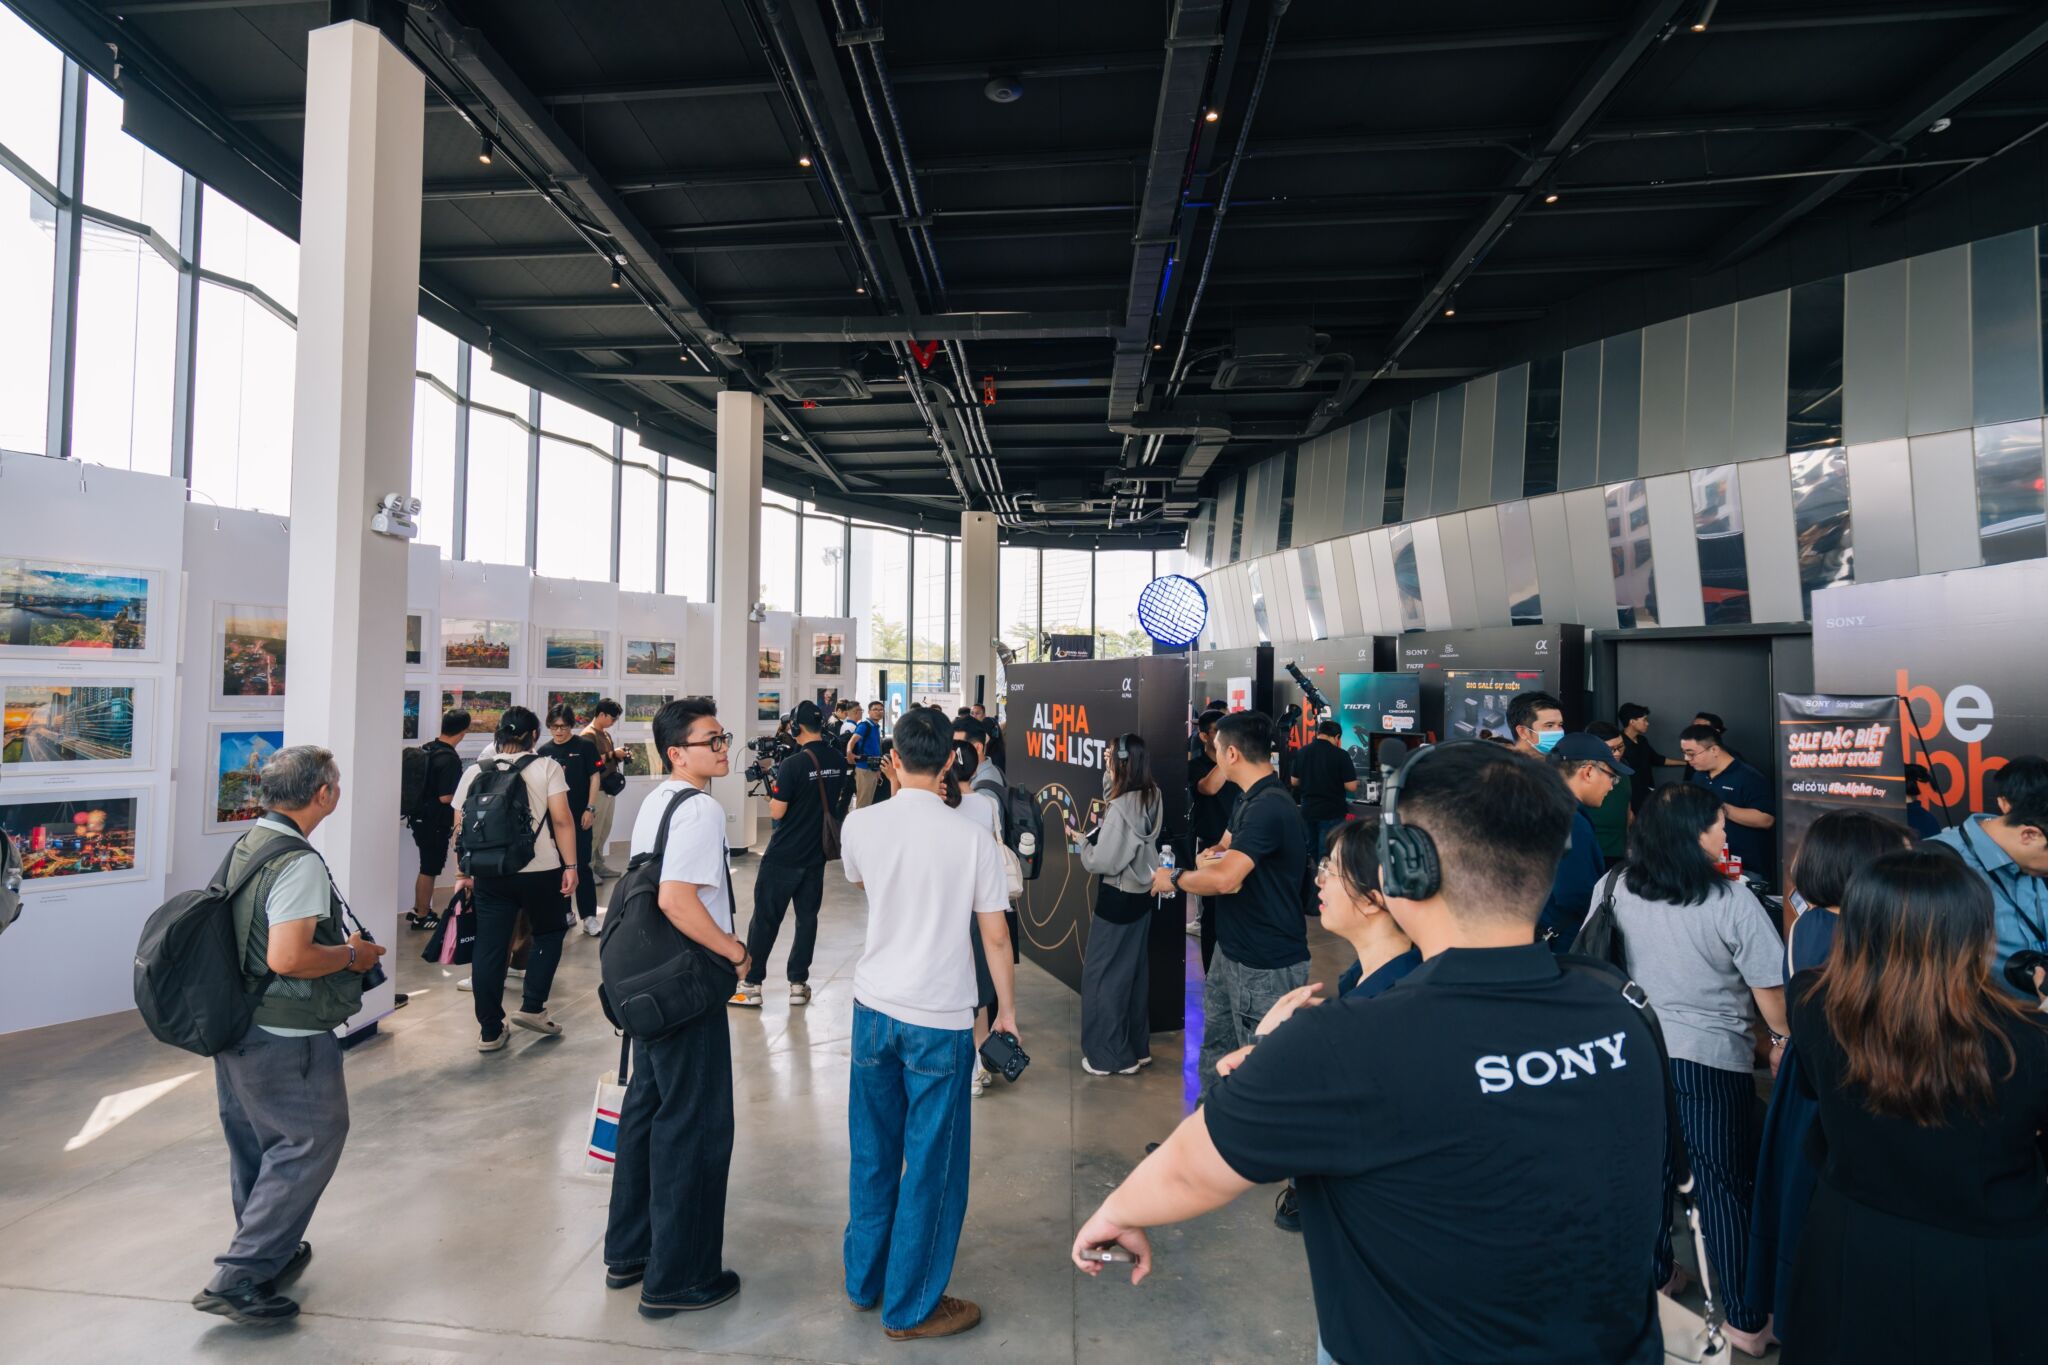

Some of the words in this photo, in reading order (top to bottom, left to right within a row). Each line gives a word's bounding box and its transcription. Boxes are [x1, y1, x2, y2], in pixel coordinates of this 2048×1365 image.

[1825, 616, 1866, 629] SONY
[1805, 699, 1831, 708] SONY
[1032, 703, 1090, 735] ALPHA
[1026, 731, 1106, 770] WISHLIST
[1788, 732, 1823, 752] SALE
[1846, 750, 1884, 767] STORE
[1805, 782, 1817, 792] CÓ
[1872, 788, 1887, 798] Day
[1474, 1031, 1627, 1094] SONY
